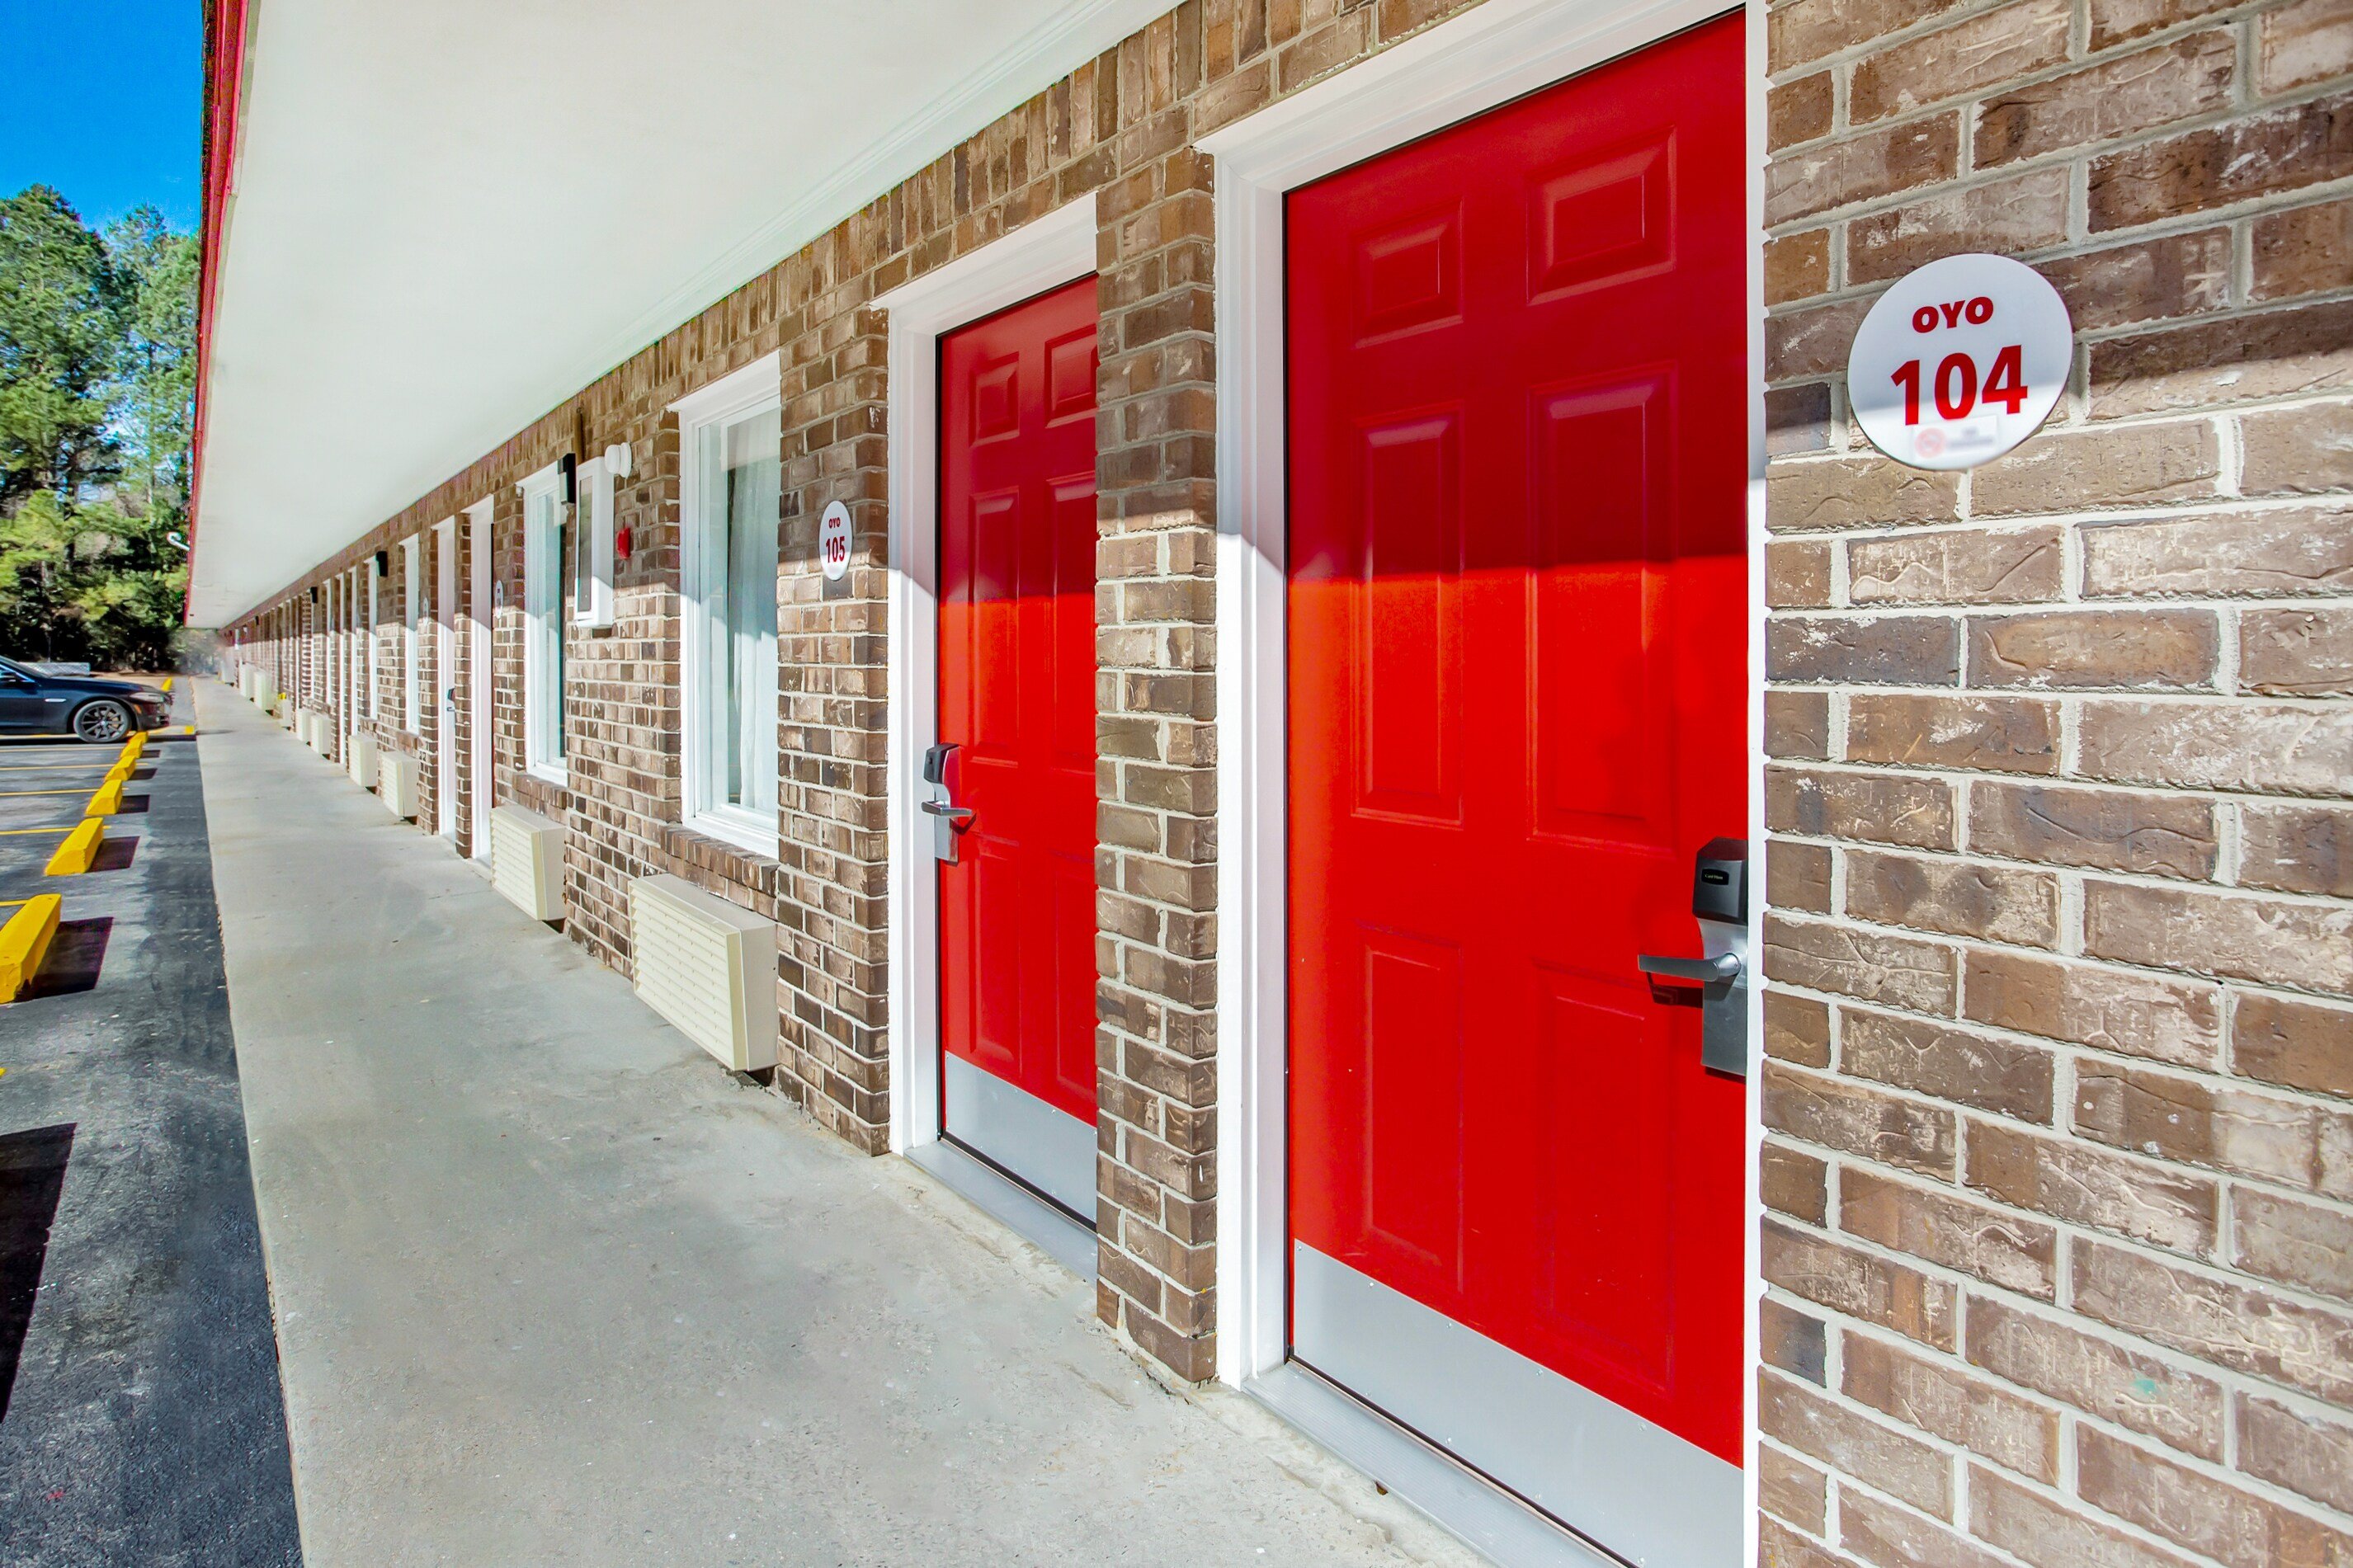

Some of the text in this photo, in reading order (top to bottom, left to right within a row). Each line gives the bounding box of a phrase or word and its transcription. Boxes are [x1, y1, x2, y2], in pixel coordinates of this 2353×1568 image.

[1912, 296, 1994, 333] OYO
[1891, 345, 2028, 426] 104
[828, 517, 841, 529] OYO
[826, 535, 846, 563] 105
